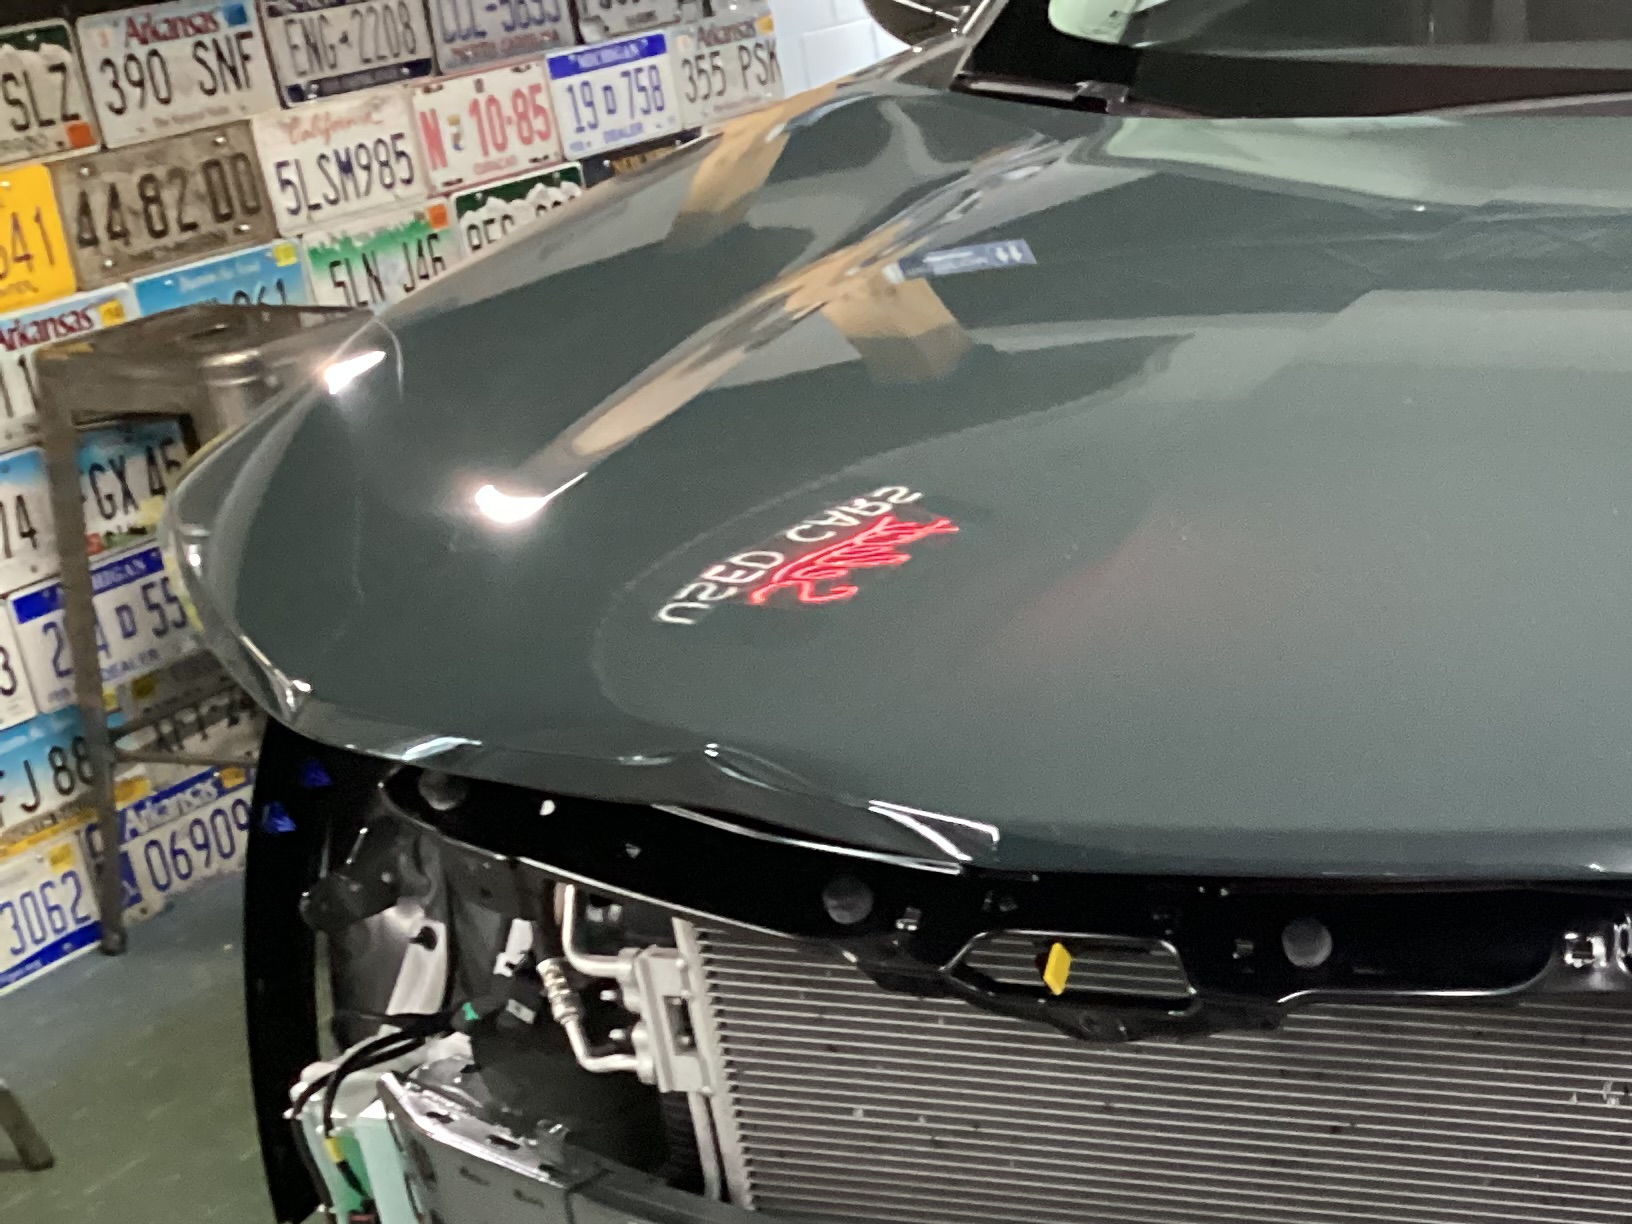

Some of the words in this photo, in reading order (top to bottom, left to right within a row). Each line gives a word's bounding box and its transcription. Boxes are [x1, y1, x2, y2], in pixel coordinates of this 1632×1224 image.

[100, 48, 172, 116] 390
[192, 31, 254, 96] SNF
[566, 79, 599, 134] 19
[620, 64, 665, 120] 758
[681, 50, 728, 104] 355
[418, 108, 448, 171] N
[467, 83, 550, 157] 10-85
